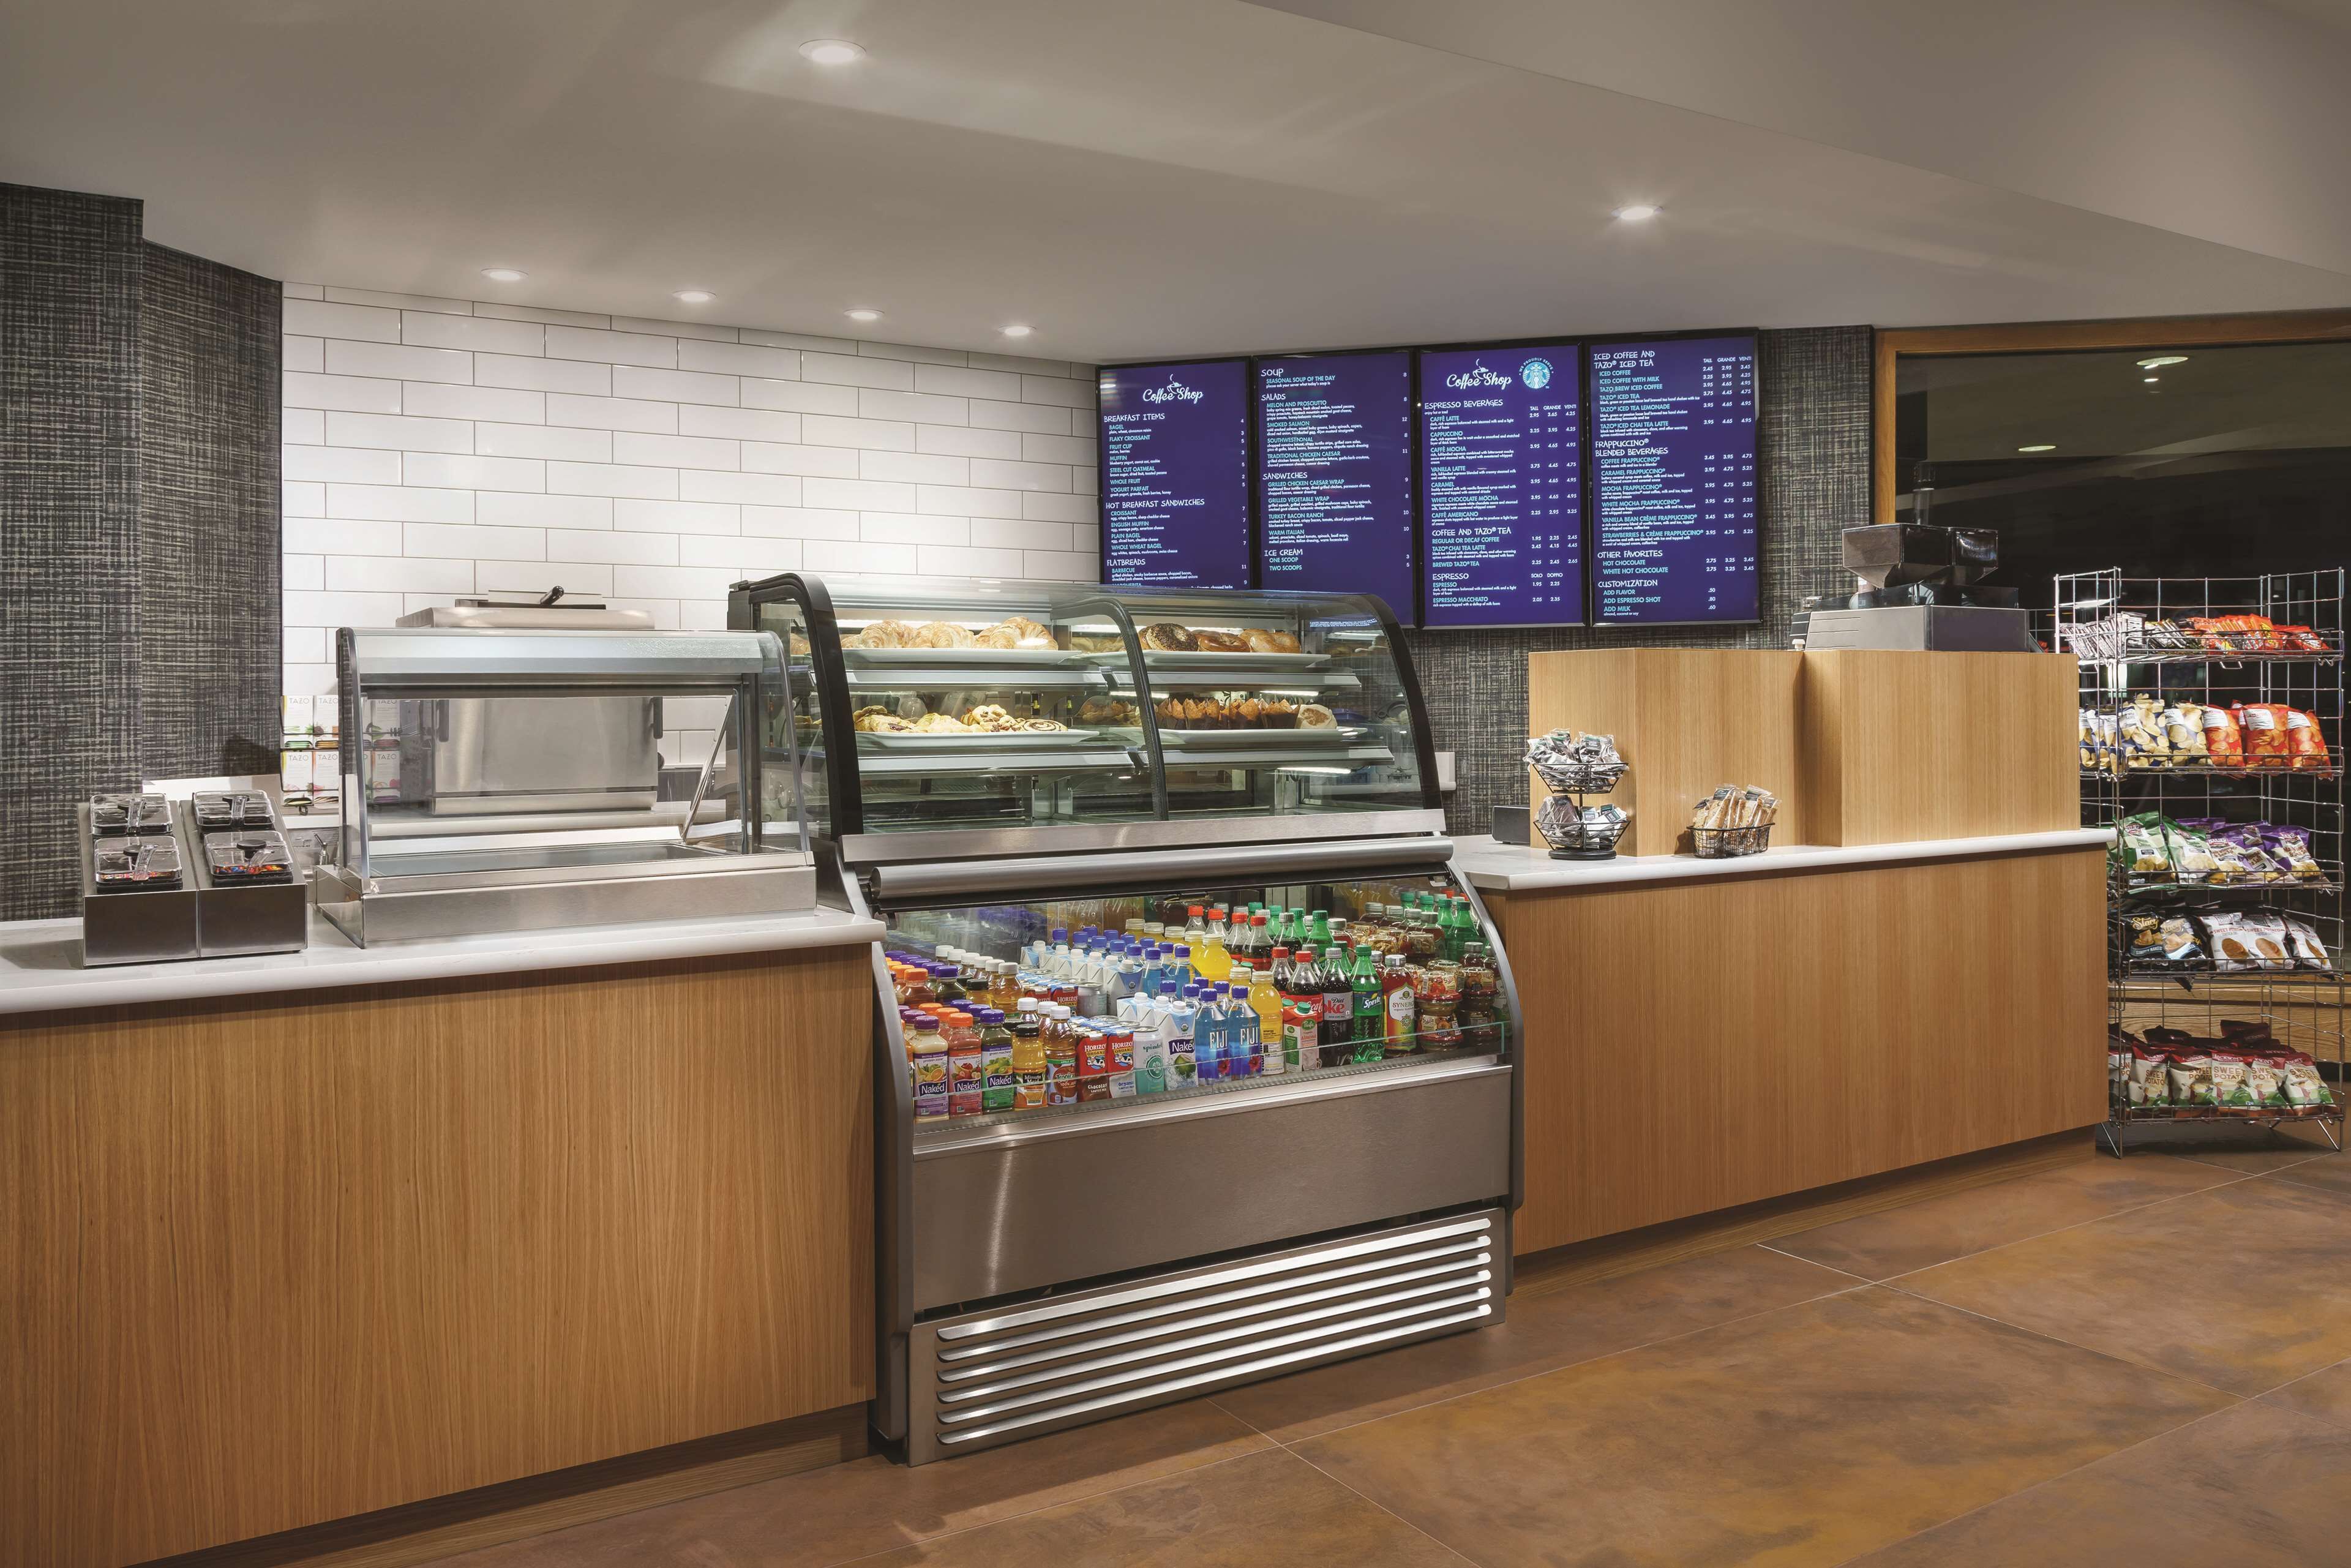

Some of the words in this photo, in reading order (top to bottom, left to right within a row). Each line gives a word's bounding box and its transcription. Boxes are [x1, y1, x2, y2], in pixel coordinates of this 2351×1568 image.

[1641, 350, 1655, 359] AND
[1261, 368, 1283, 377] SOUP
[1447, 373, 1481, 389] Coffee
[1483, 372, 1512, 390] Shop
[1142, 388, 1175, 403] Coffee
[1177, 387, 1204, 403] Shop
[1425, 401, 1461, 410] ESPRESSO
[1363, 997, 1381, 1008] Sprite
[1210, 1030, 1228, 1049] FIJI
[1240, 1027, 1258, 1045] FIJI
[990, 1076, 1011, 1086] Naked
[921, 1084, 944, 1093] Naked
[958, 1082, 979, 1092] Naked
